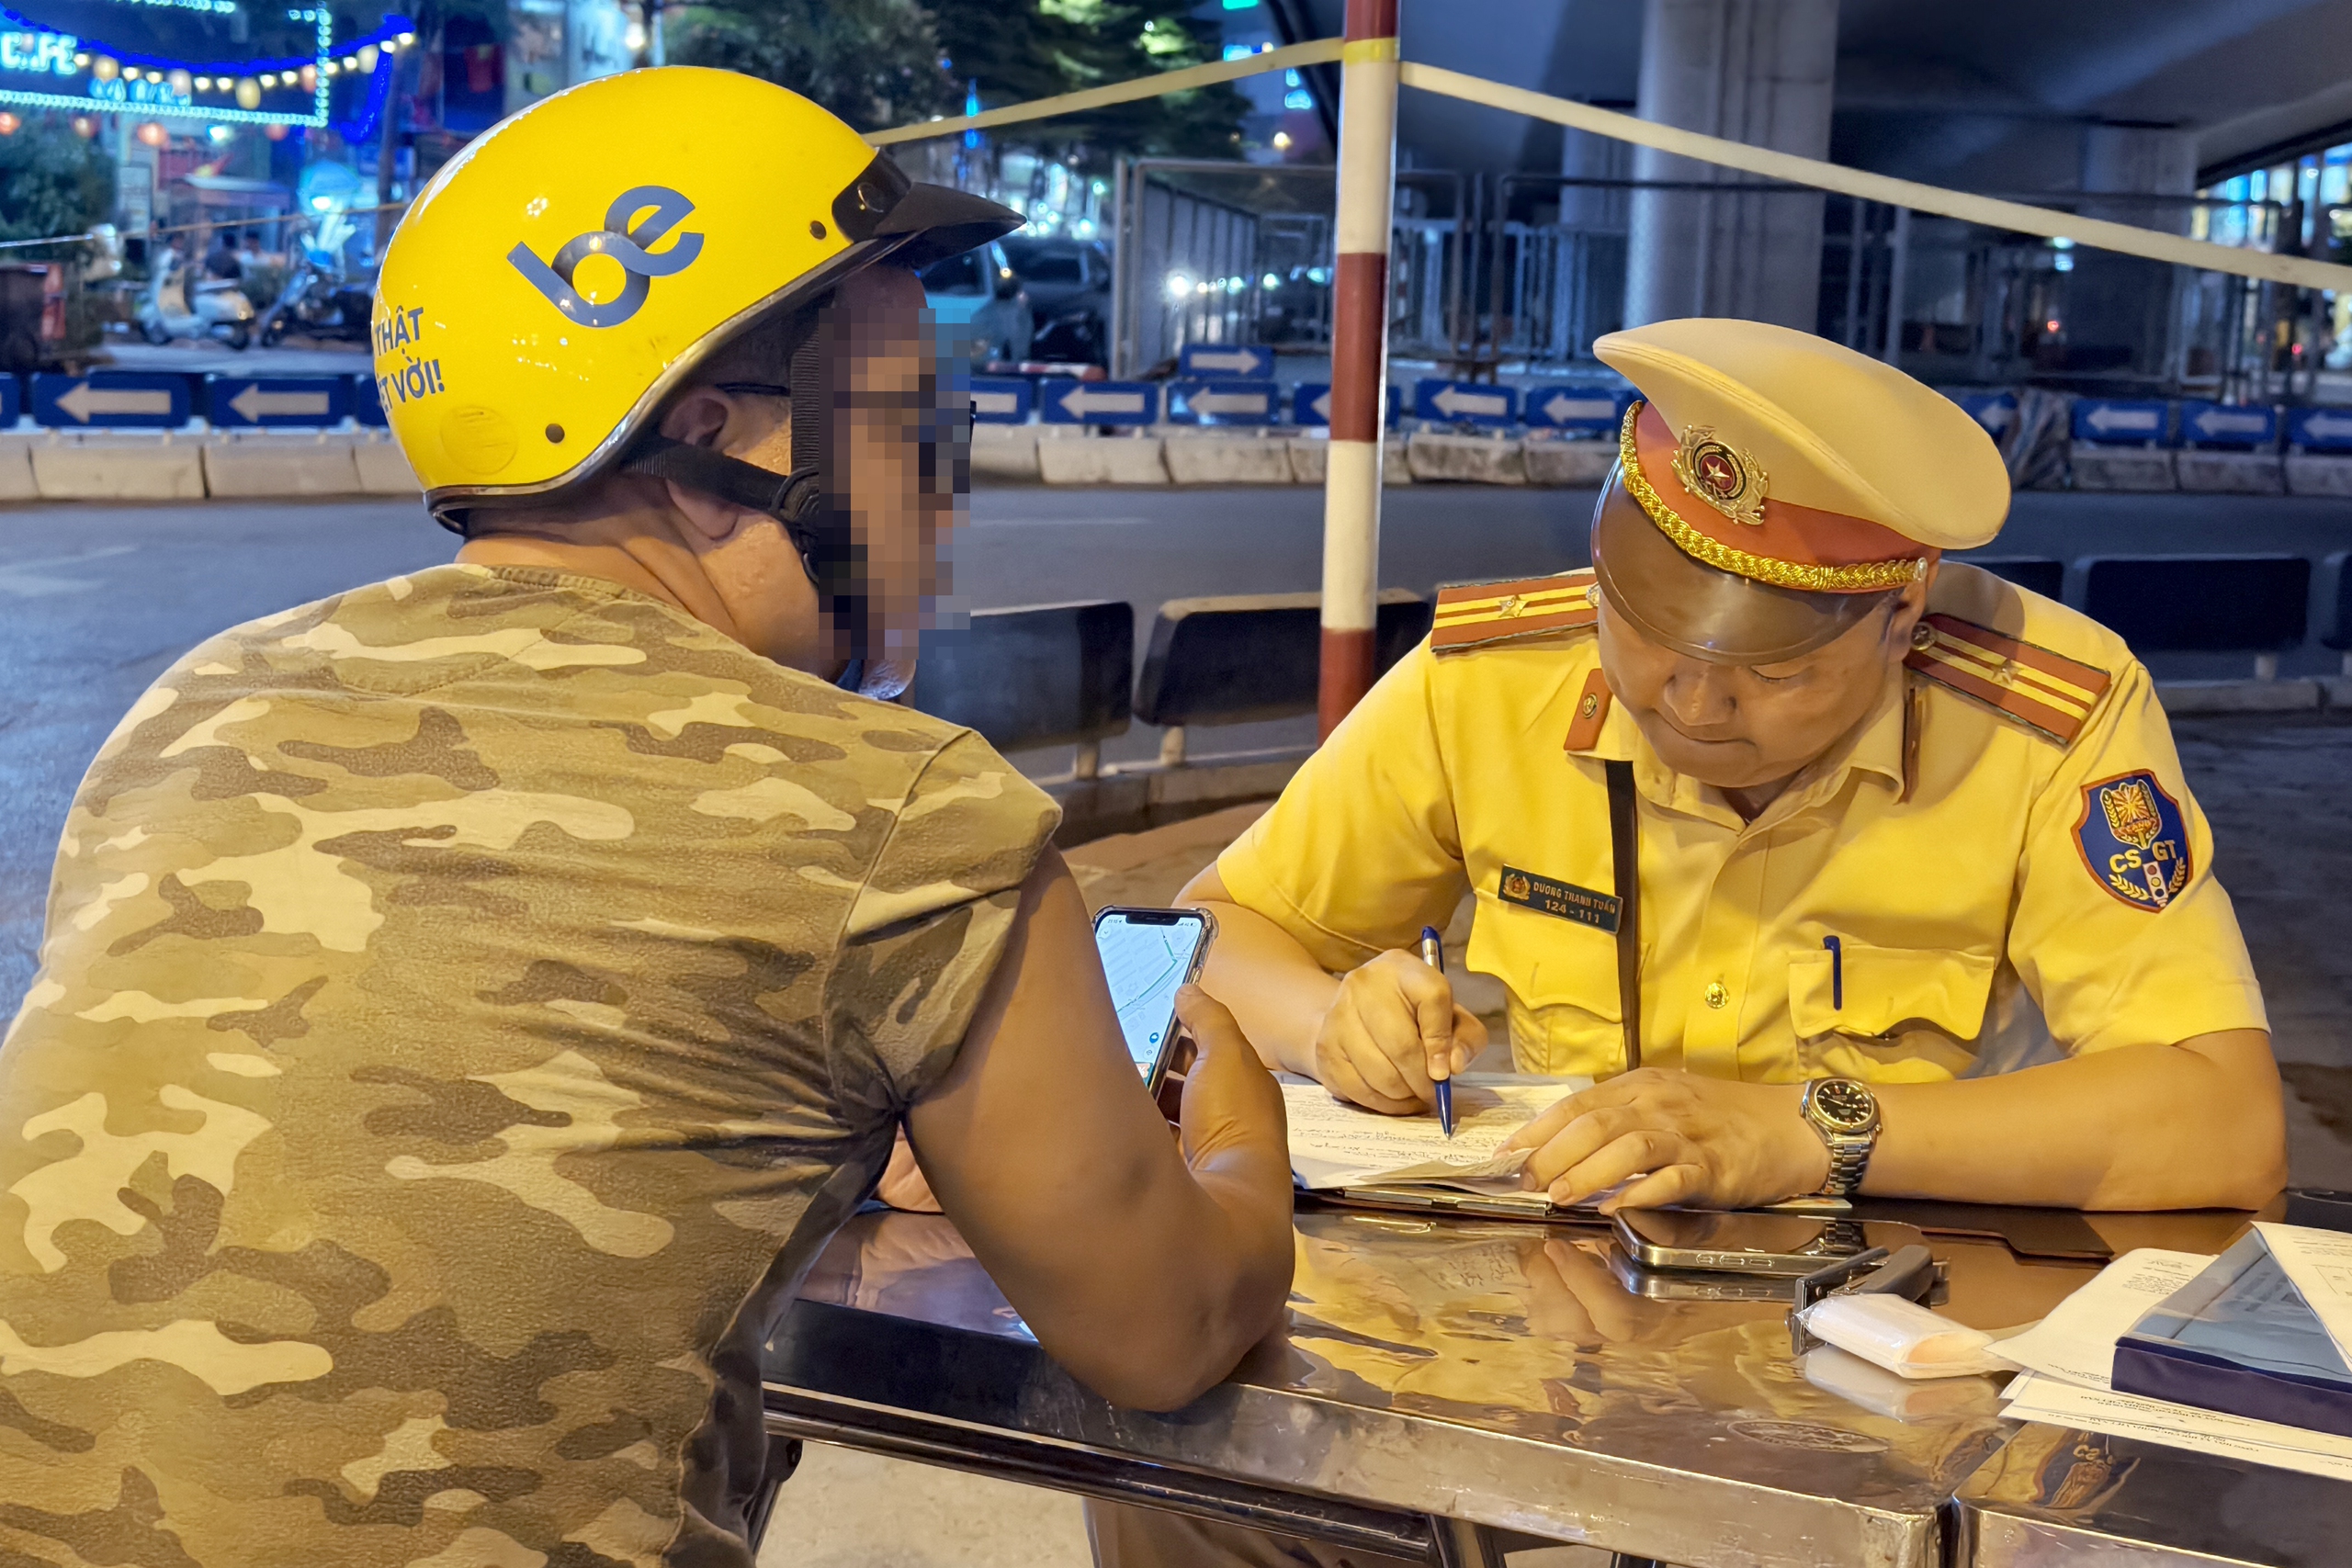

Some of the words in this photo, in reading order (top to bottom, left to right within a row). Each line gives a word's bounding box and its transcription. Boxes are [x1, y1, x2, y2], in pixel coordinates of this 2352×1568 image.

[507, 185, 705, 328] be
[375, 304, 424, 356] THẬT
[390, 355, 445, 403] VỜI!
[1544, 899, 1566, 914] 124
[1579, 908, 1600, 924] 111
